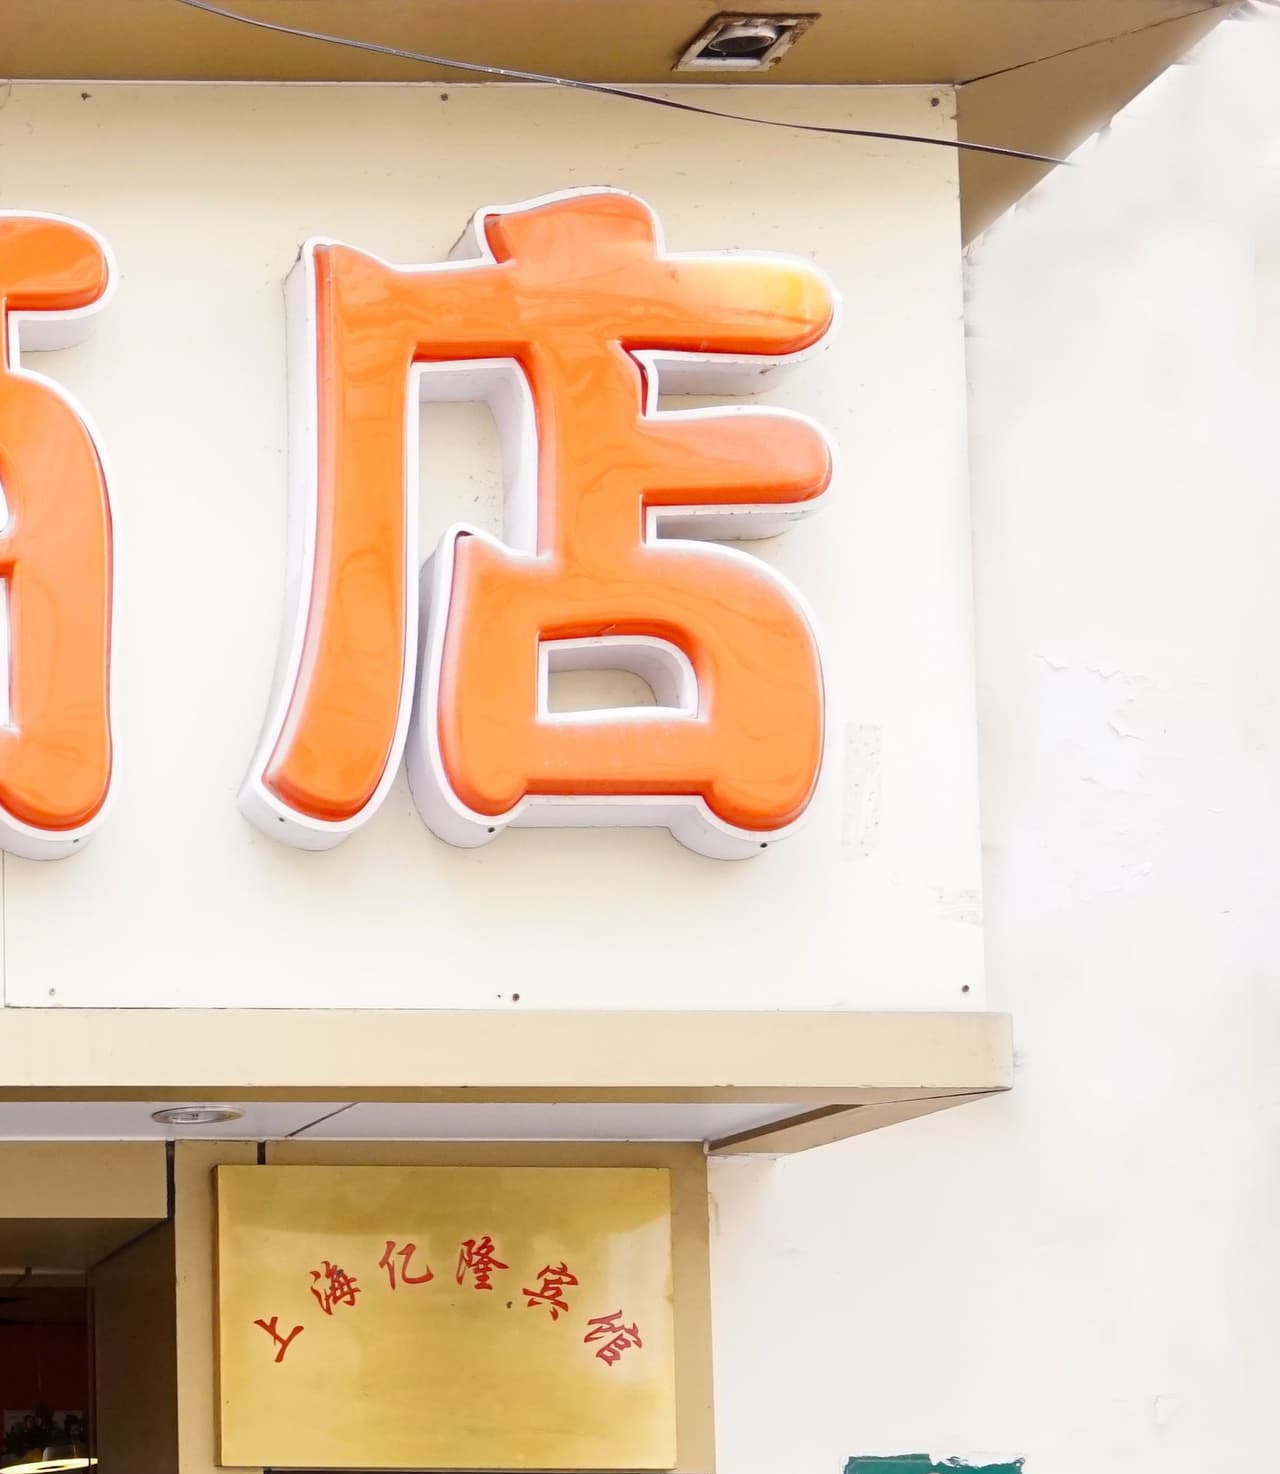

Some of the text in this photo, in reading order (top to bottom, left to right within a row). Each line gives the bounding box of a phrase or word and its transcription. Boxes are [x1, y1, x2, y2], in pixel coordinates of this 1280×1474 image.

[254, 1235, 643, 1367] 上海亿隆宾馆
